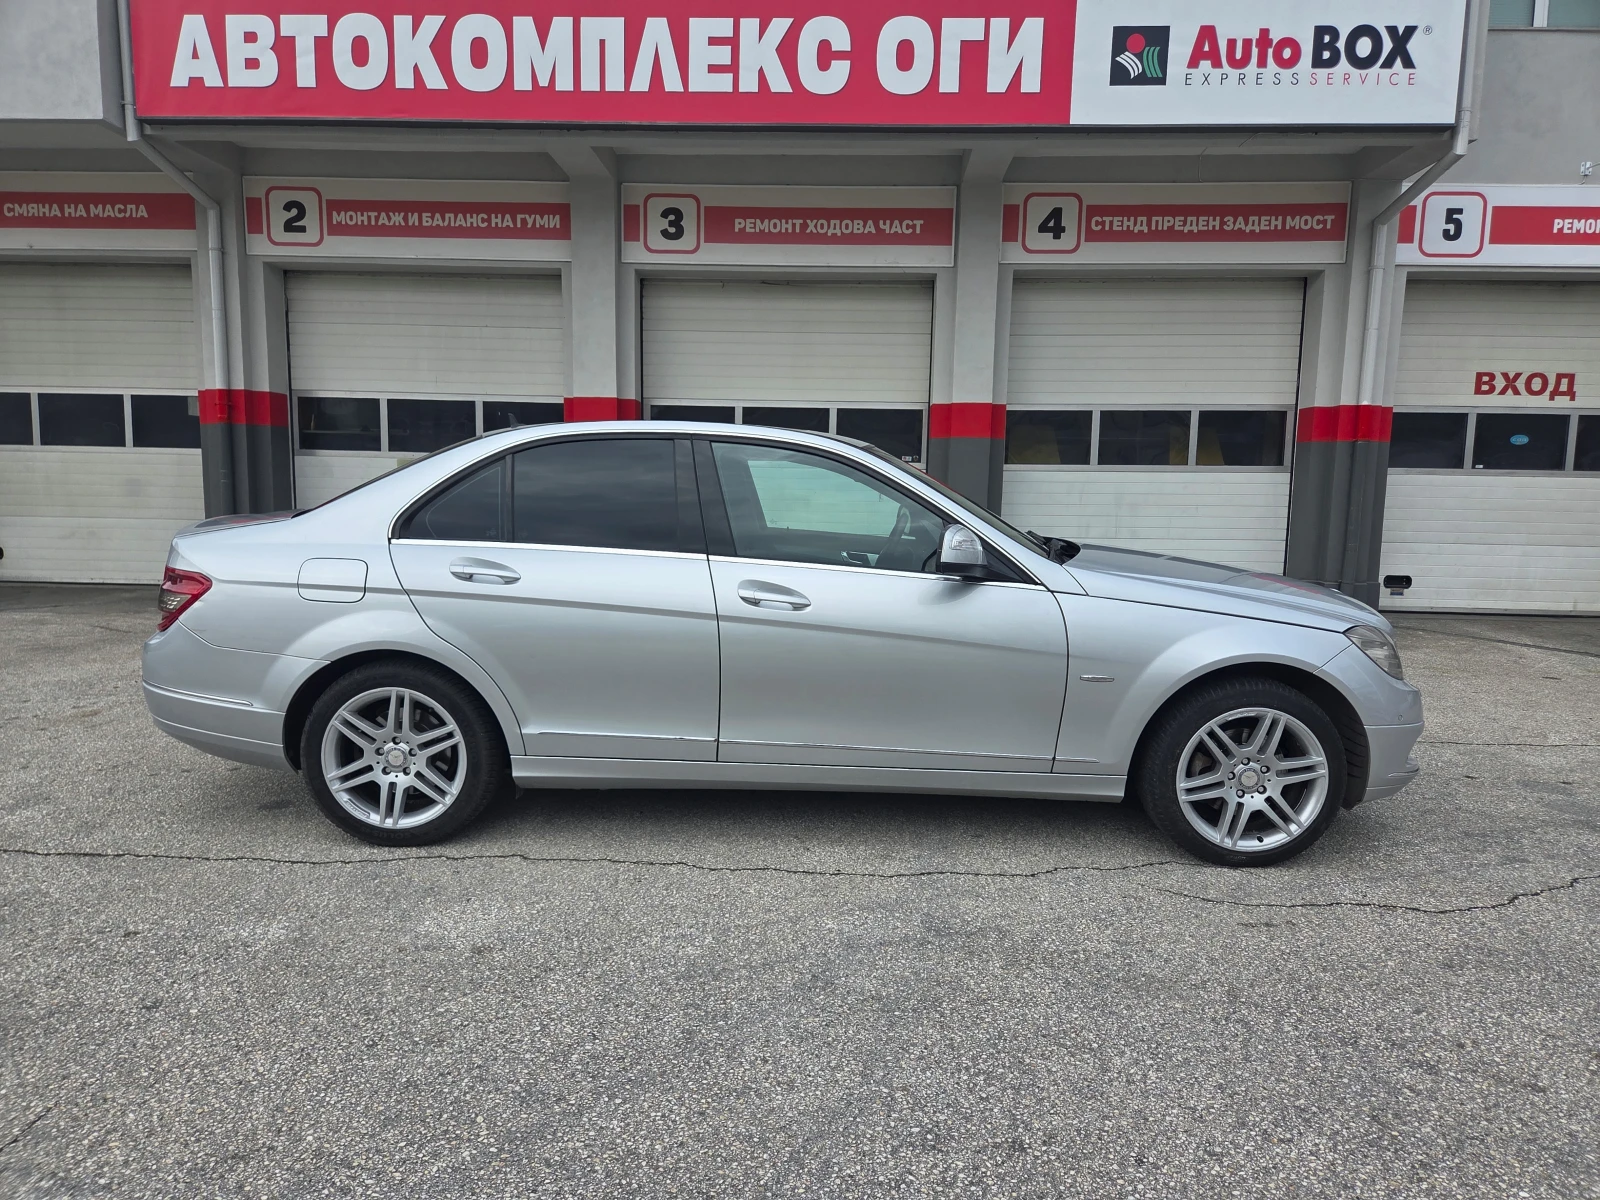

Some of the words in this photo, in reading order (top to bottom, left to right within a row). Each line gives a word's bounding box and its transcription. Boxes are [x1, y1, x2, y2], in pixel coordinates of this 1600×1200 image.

[169, 12, 851, 95] АВТОКОМПЛЕКС
[876, 15, 1045, 95] ОГИ
[1186, 24, 1302, 70] Auto
[3, 203, 61, 218] СМЯНА
[64, 204, 87, 218] НА
[90, 203, 149, 219] МАСЛА
[282, 199, 307, 233] 2
[332, 210, 405, 226] МОНТАЖ
[408, 212, 419, 227] И
[422, 212, 488, 228] БАЛАНС
[491, 213, 514, 228] НА
[516, 213, 561, 229] ГУМИ
[659, 206, 685, 241] 3
[734, 218, 803, 233] РЕМОНТ
[806, 219, 876, 236] ХОДОВА
[879, 219, 924, 234] ЧАСТ
[1037, 206, 1066, 240] 4
[1091, 216, 1148, 233] СТЕНД
[1151, 216, 1220, 232] ПРЕДЕН
[1223, 215, 1282, 232] ЗАДЕН
[1285, 214, 1335, 230] МОСТ
[1442, 207, 1464, 242] 5
[1473, 371, 1577, 402] ВХОД
